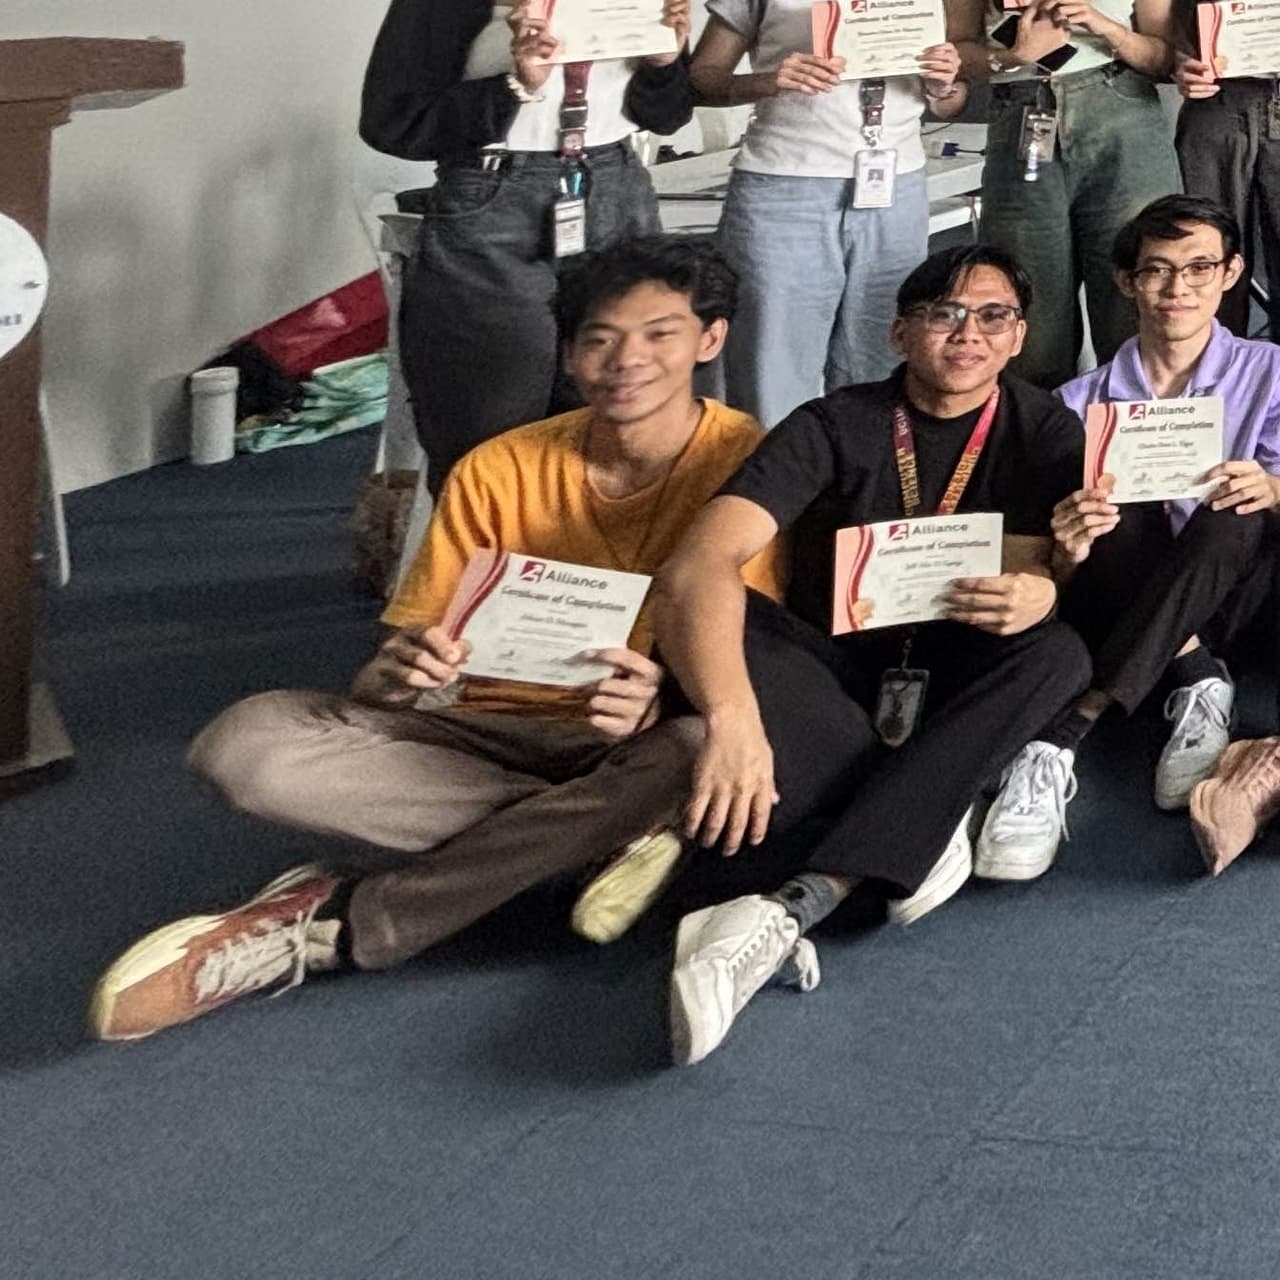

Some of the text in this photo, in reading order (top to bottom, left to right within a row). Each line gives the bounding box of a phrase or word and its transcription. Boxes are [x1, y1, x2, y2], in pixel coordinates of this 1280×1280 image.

[1148, 405, 1196, 415] Alliance
[912, 523, 968, 535] Alliance
[546, 570, 608, 590] Alliance
